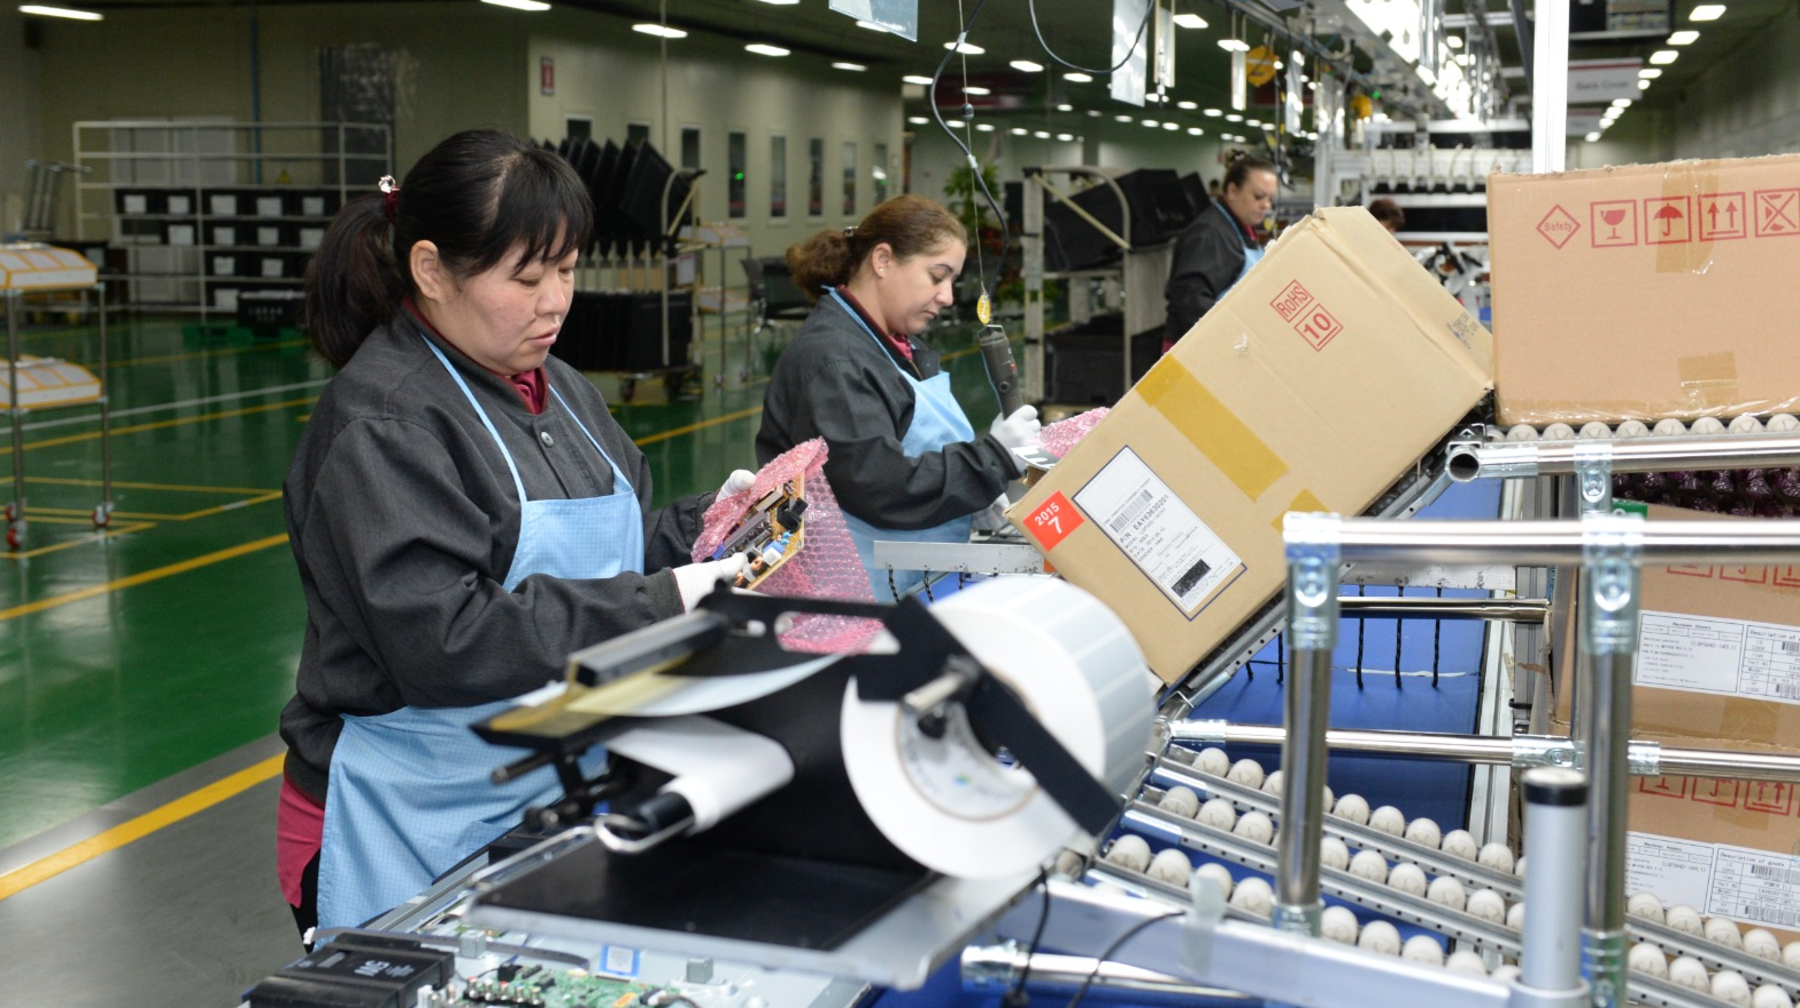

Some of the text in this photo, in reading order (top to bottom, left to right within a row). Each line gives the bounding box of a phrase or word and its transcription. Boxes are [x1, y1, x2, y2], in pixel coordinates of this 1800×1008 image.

[1544, 222, 1572, 232] Safety
[1276, 286, 1308, 318] RoHS
[1304, 312, 1331, 339] 10
[1034, 502, 1060, 526] 2015
[1047, 516, 1062, 534] 7
[1120, 531, 1132, 544] P/N
[1750, 630, 1786, 638] Description
[1721, 852, 1756, 862] Description
